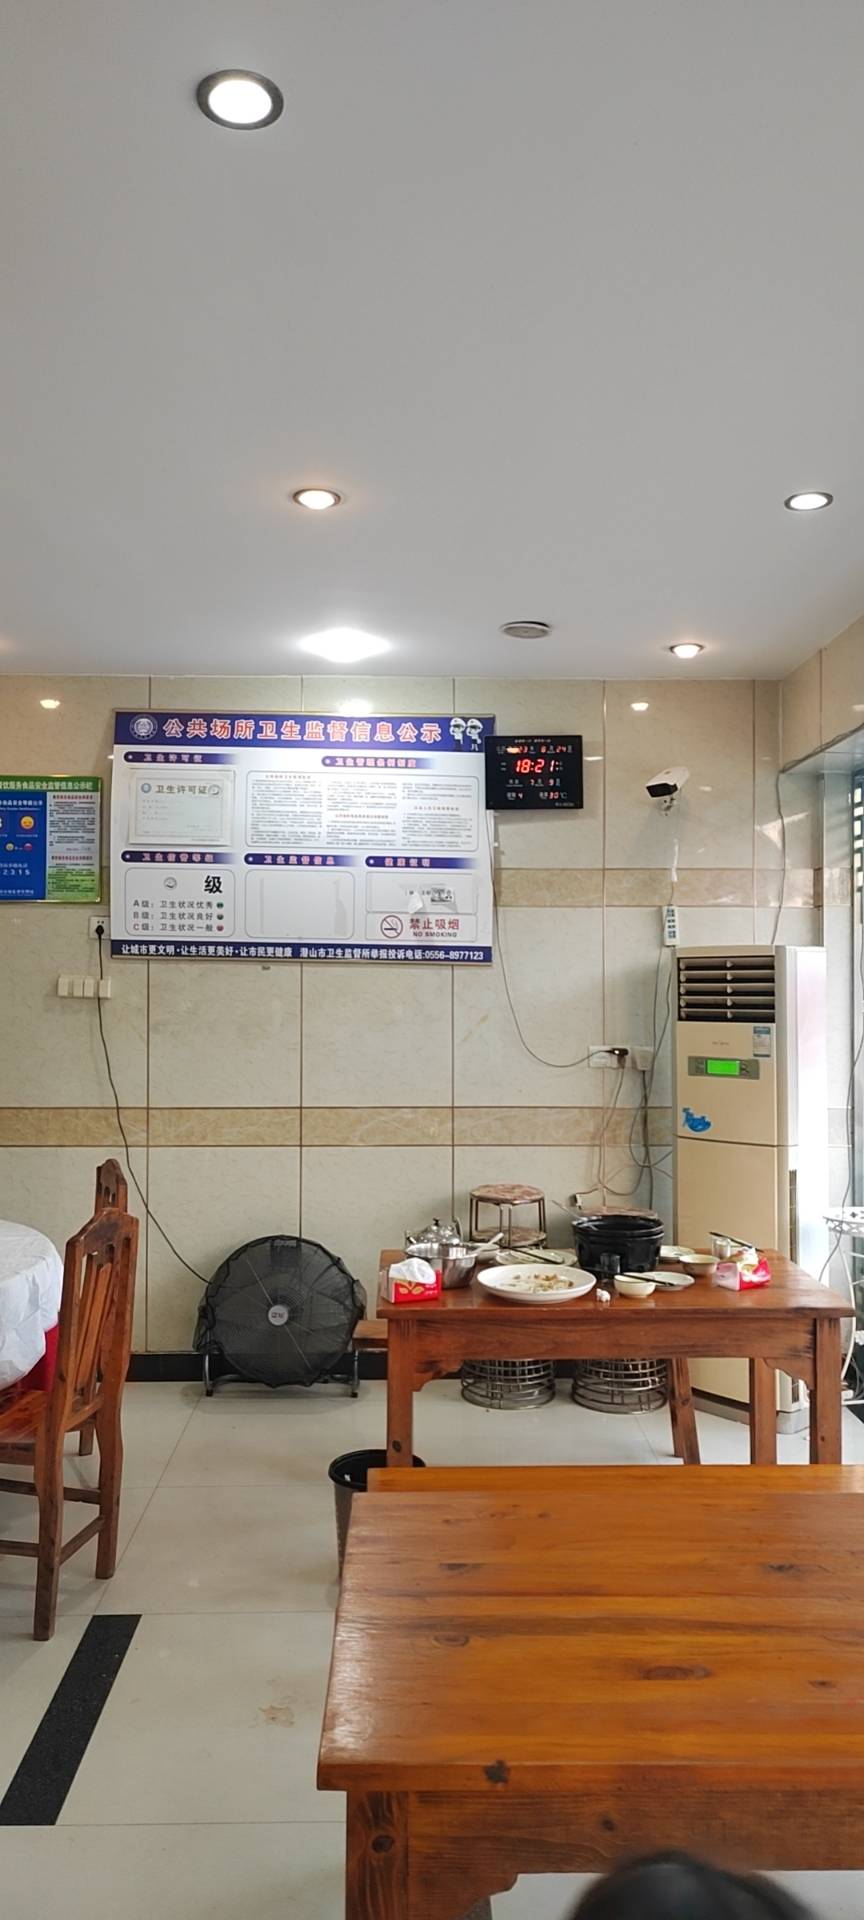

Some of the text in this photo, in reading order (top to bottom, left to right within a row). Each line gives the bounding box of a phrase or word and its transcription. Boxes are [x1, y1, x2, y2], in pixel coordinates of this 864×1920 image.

[163, 718, 442, 745] 公共场所卫生监督信息公示
[515, 758, 554, 773] 18:21
[155, 783, 208, 795] 卫生许可证
[204, 875, 223, 894] 级
[409, 918, 460, 930] 禁止吸烟
